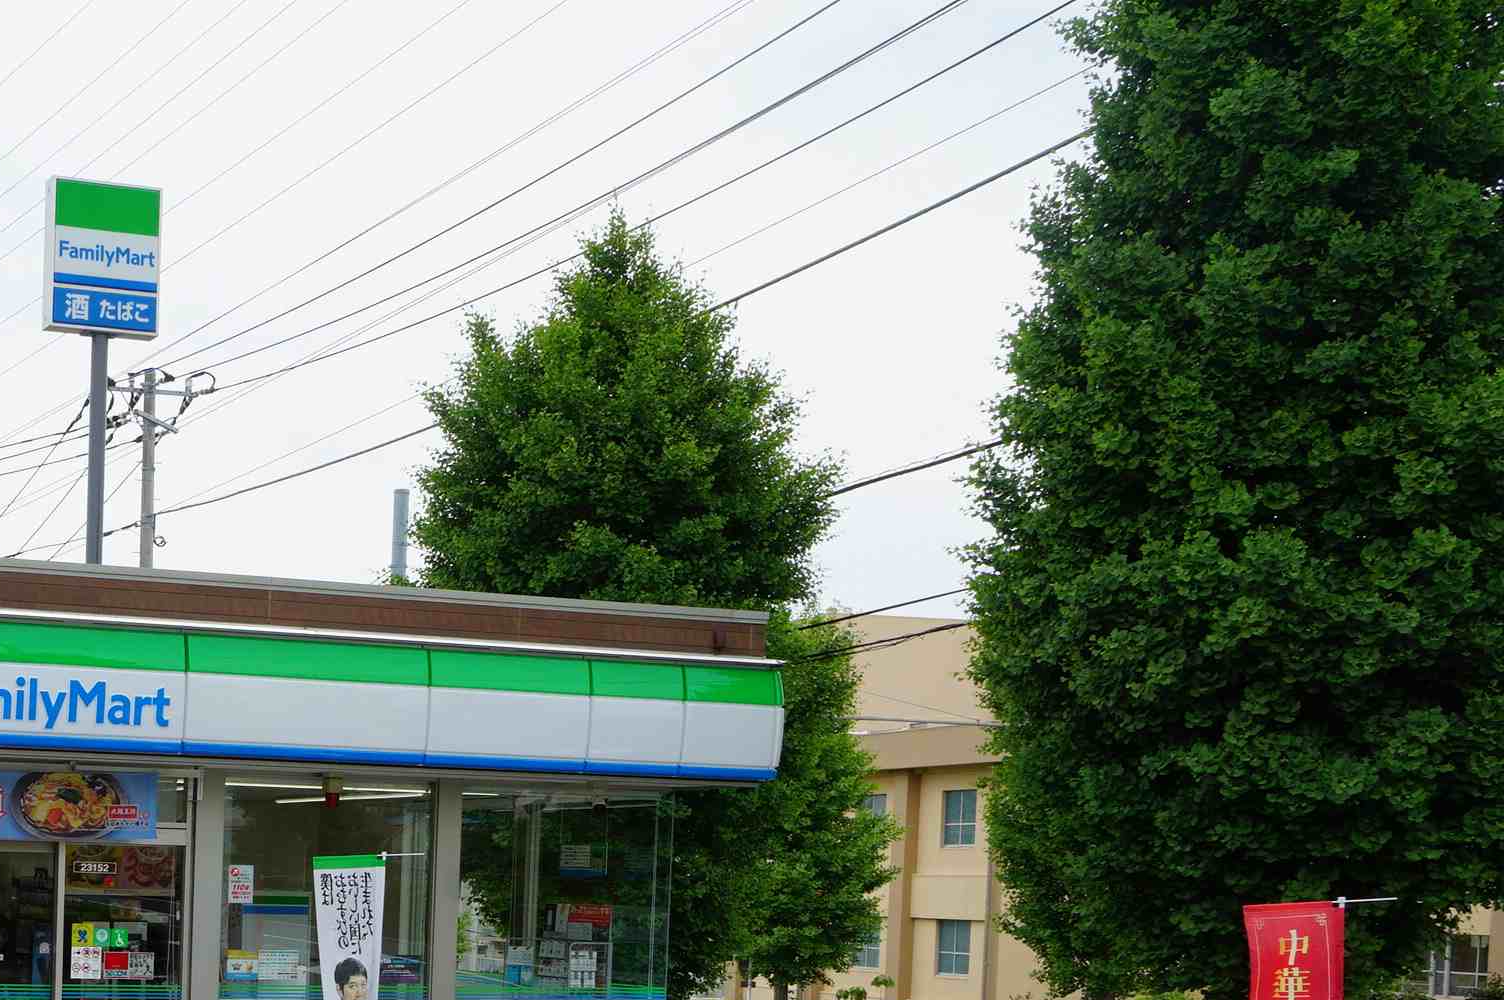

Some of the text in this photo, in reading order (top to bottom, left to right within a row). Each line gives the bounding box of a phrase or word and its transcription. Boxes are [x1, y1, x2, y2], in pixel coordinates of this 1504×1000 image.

[59, 240, 155, 267] FamilyMart
[65, 293, 149, 322] 酒 たばこ
[80, 863, 110, 872] 23152
